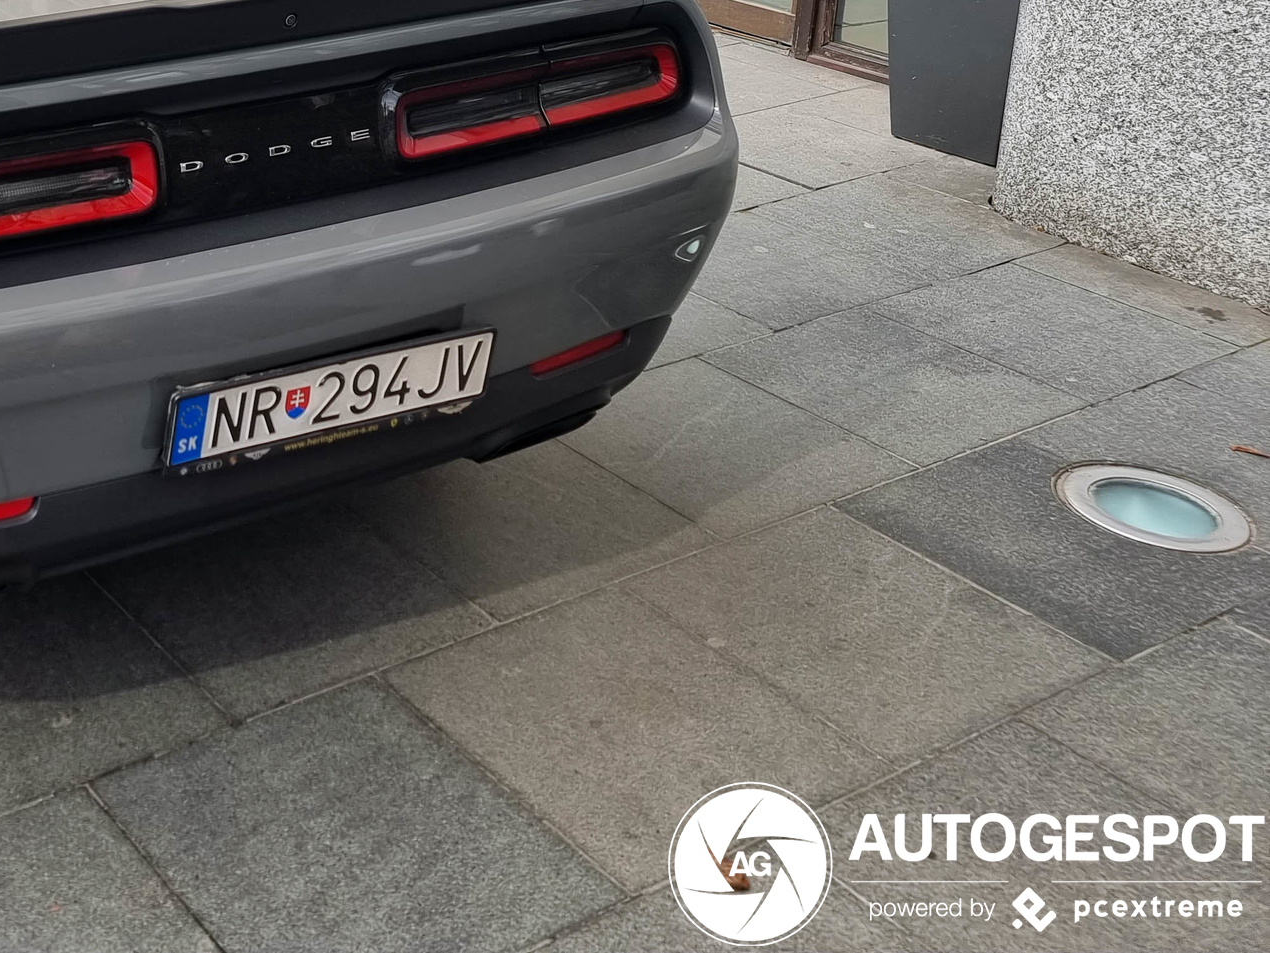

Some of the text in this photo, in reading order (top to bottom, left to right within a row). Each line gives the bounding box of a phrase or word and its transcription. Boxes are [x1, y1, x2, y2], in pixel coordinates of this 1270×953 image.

[180, 128, 370, 173] DODGE
[211, 340, 484, 449] NR 294JV
[177, 435, 199, 454] SK
